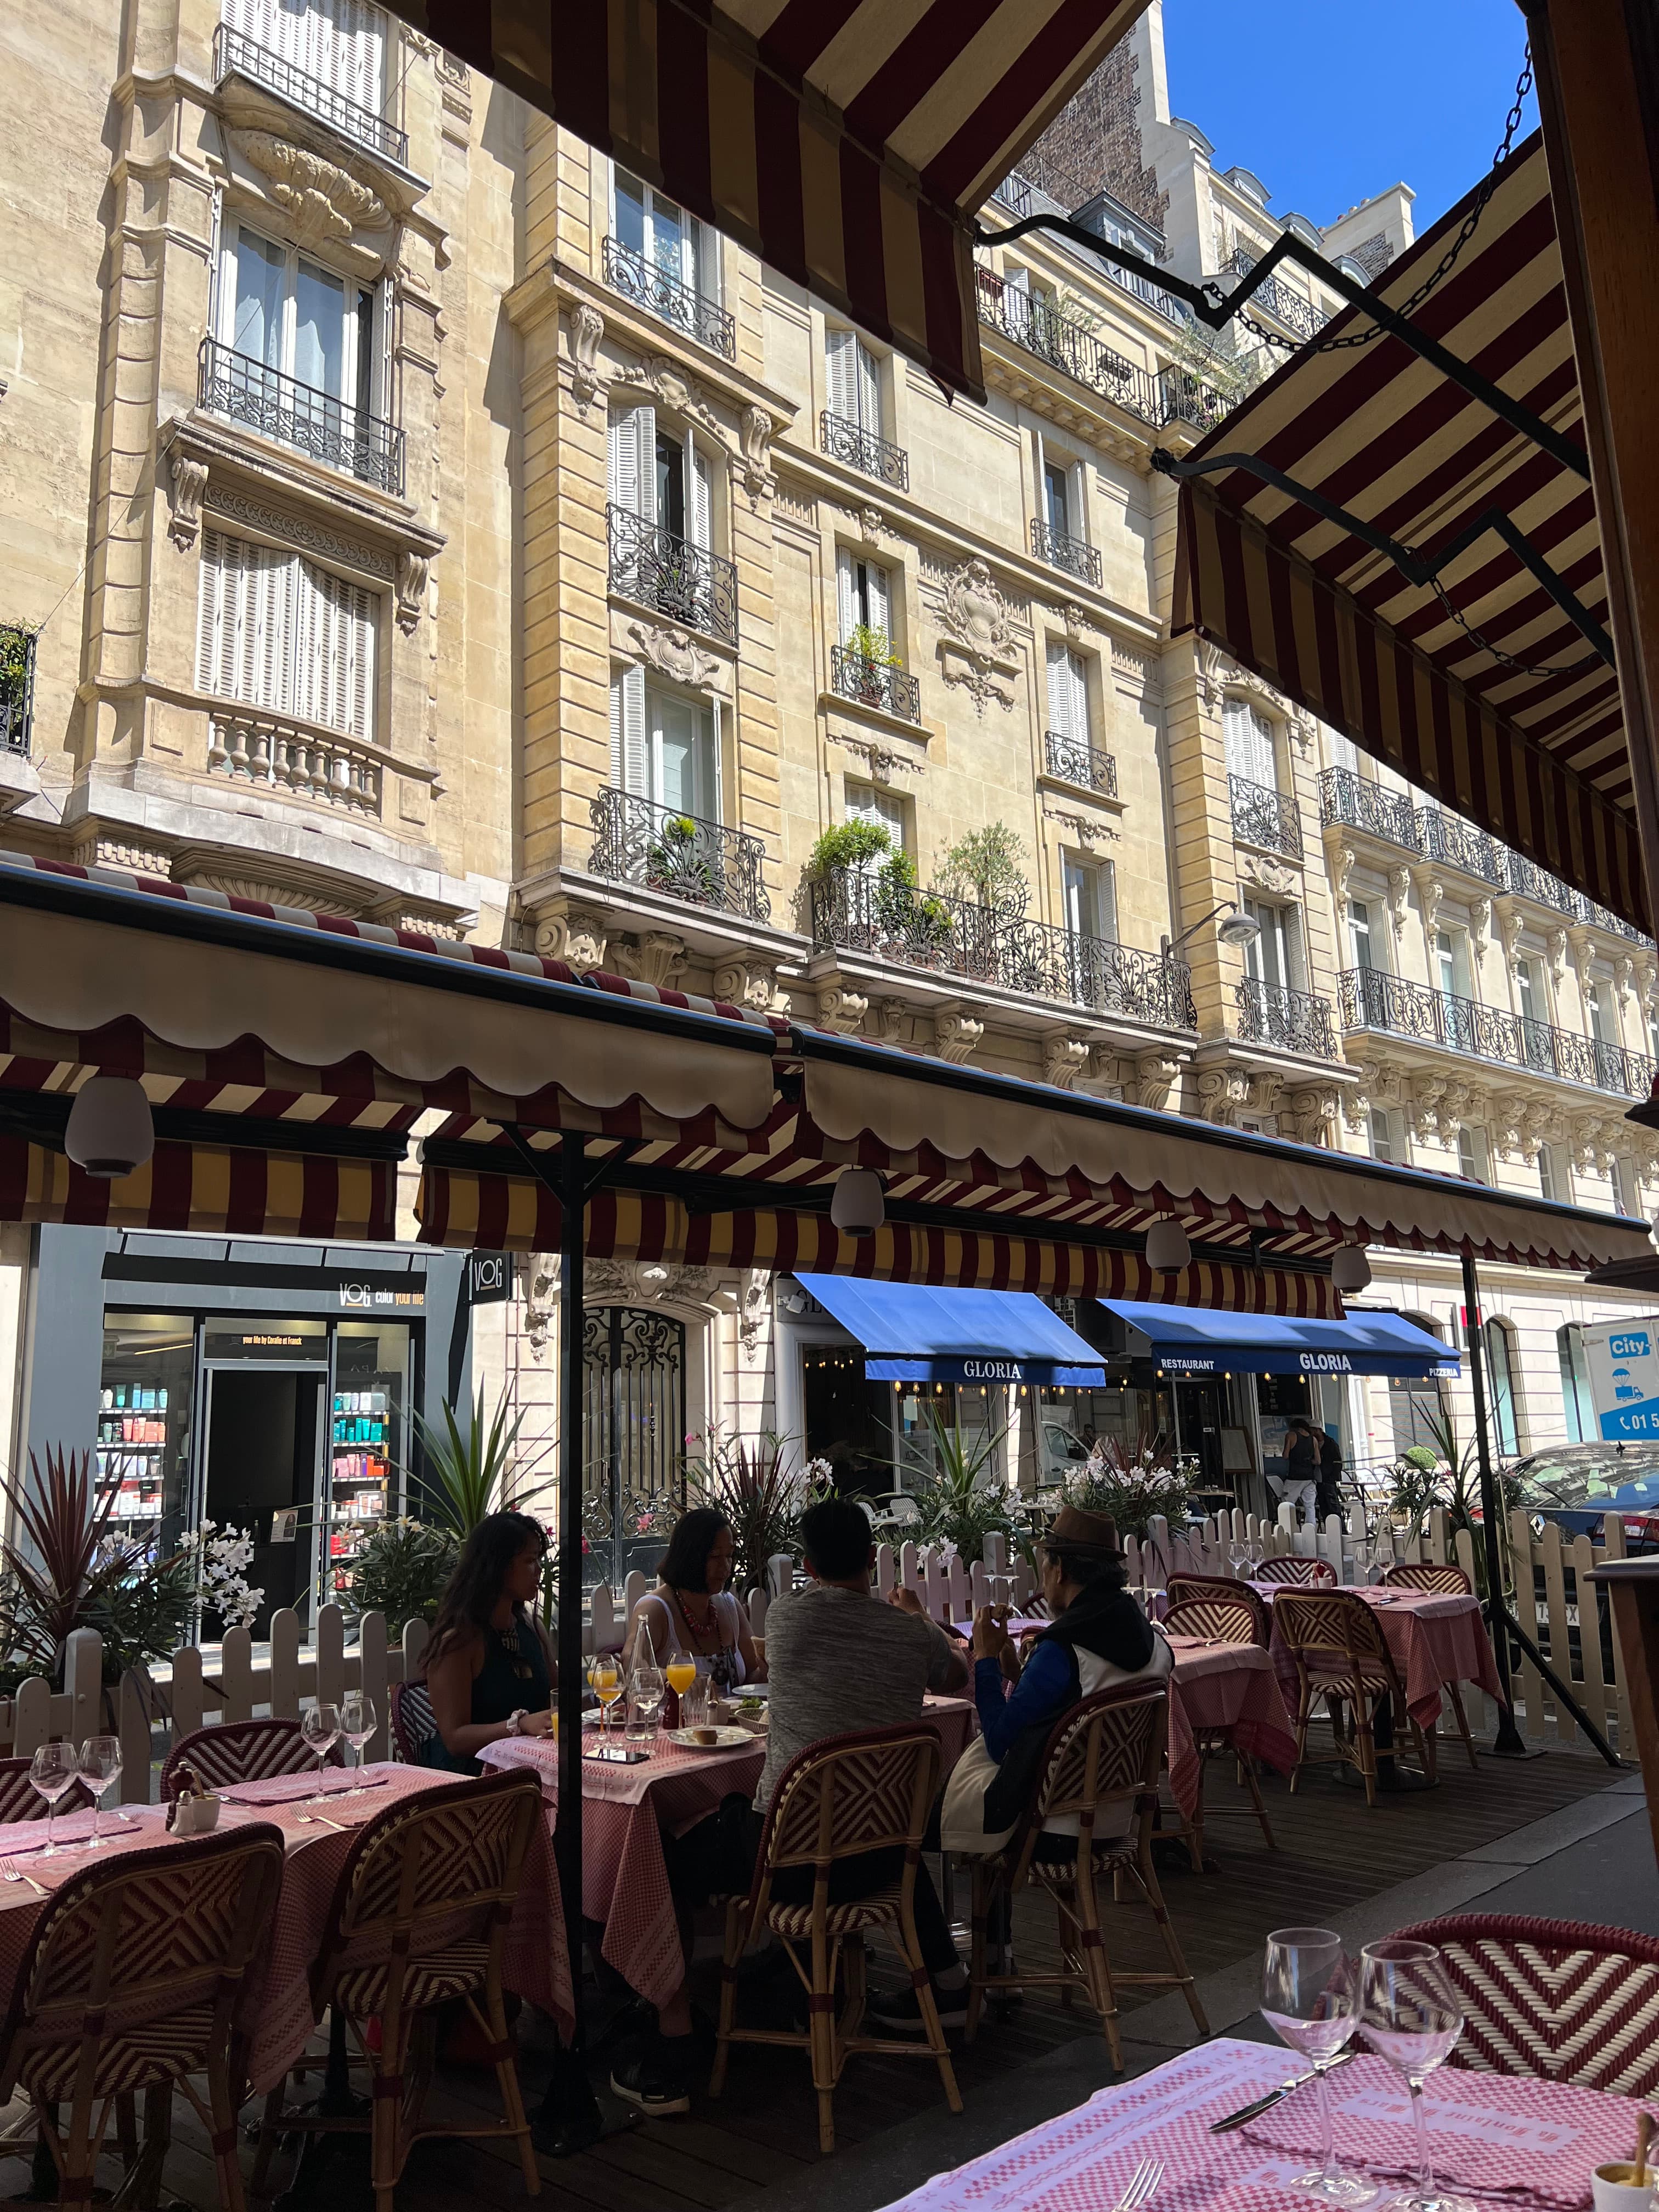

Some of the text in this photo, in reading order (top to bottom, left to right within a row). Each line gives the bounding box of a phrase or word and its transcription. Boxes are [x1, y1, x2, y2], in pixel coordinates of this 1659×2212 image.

[475, 1257, 503, 1291] VOG
[375, 1288, 394, 1304] color
[395, 1292, 411, 1306] your
[964, 1360, 1022, 1379] GLORIA
[1160, 1352, 1459, 1377] RESTAURANT GLORIA PIZZERIA
[1631, 1413, 1647, 1430] 01
